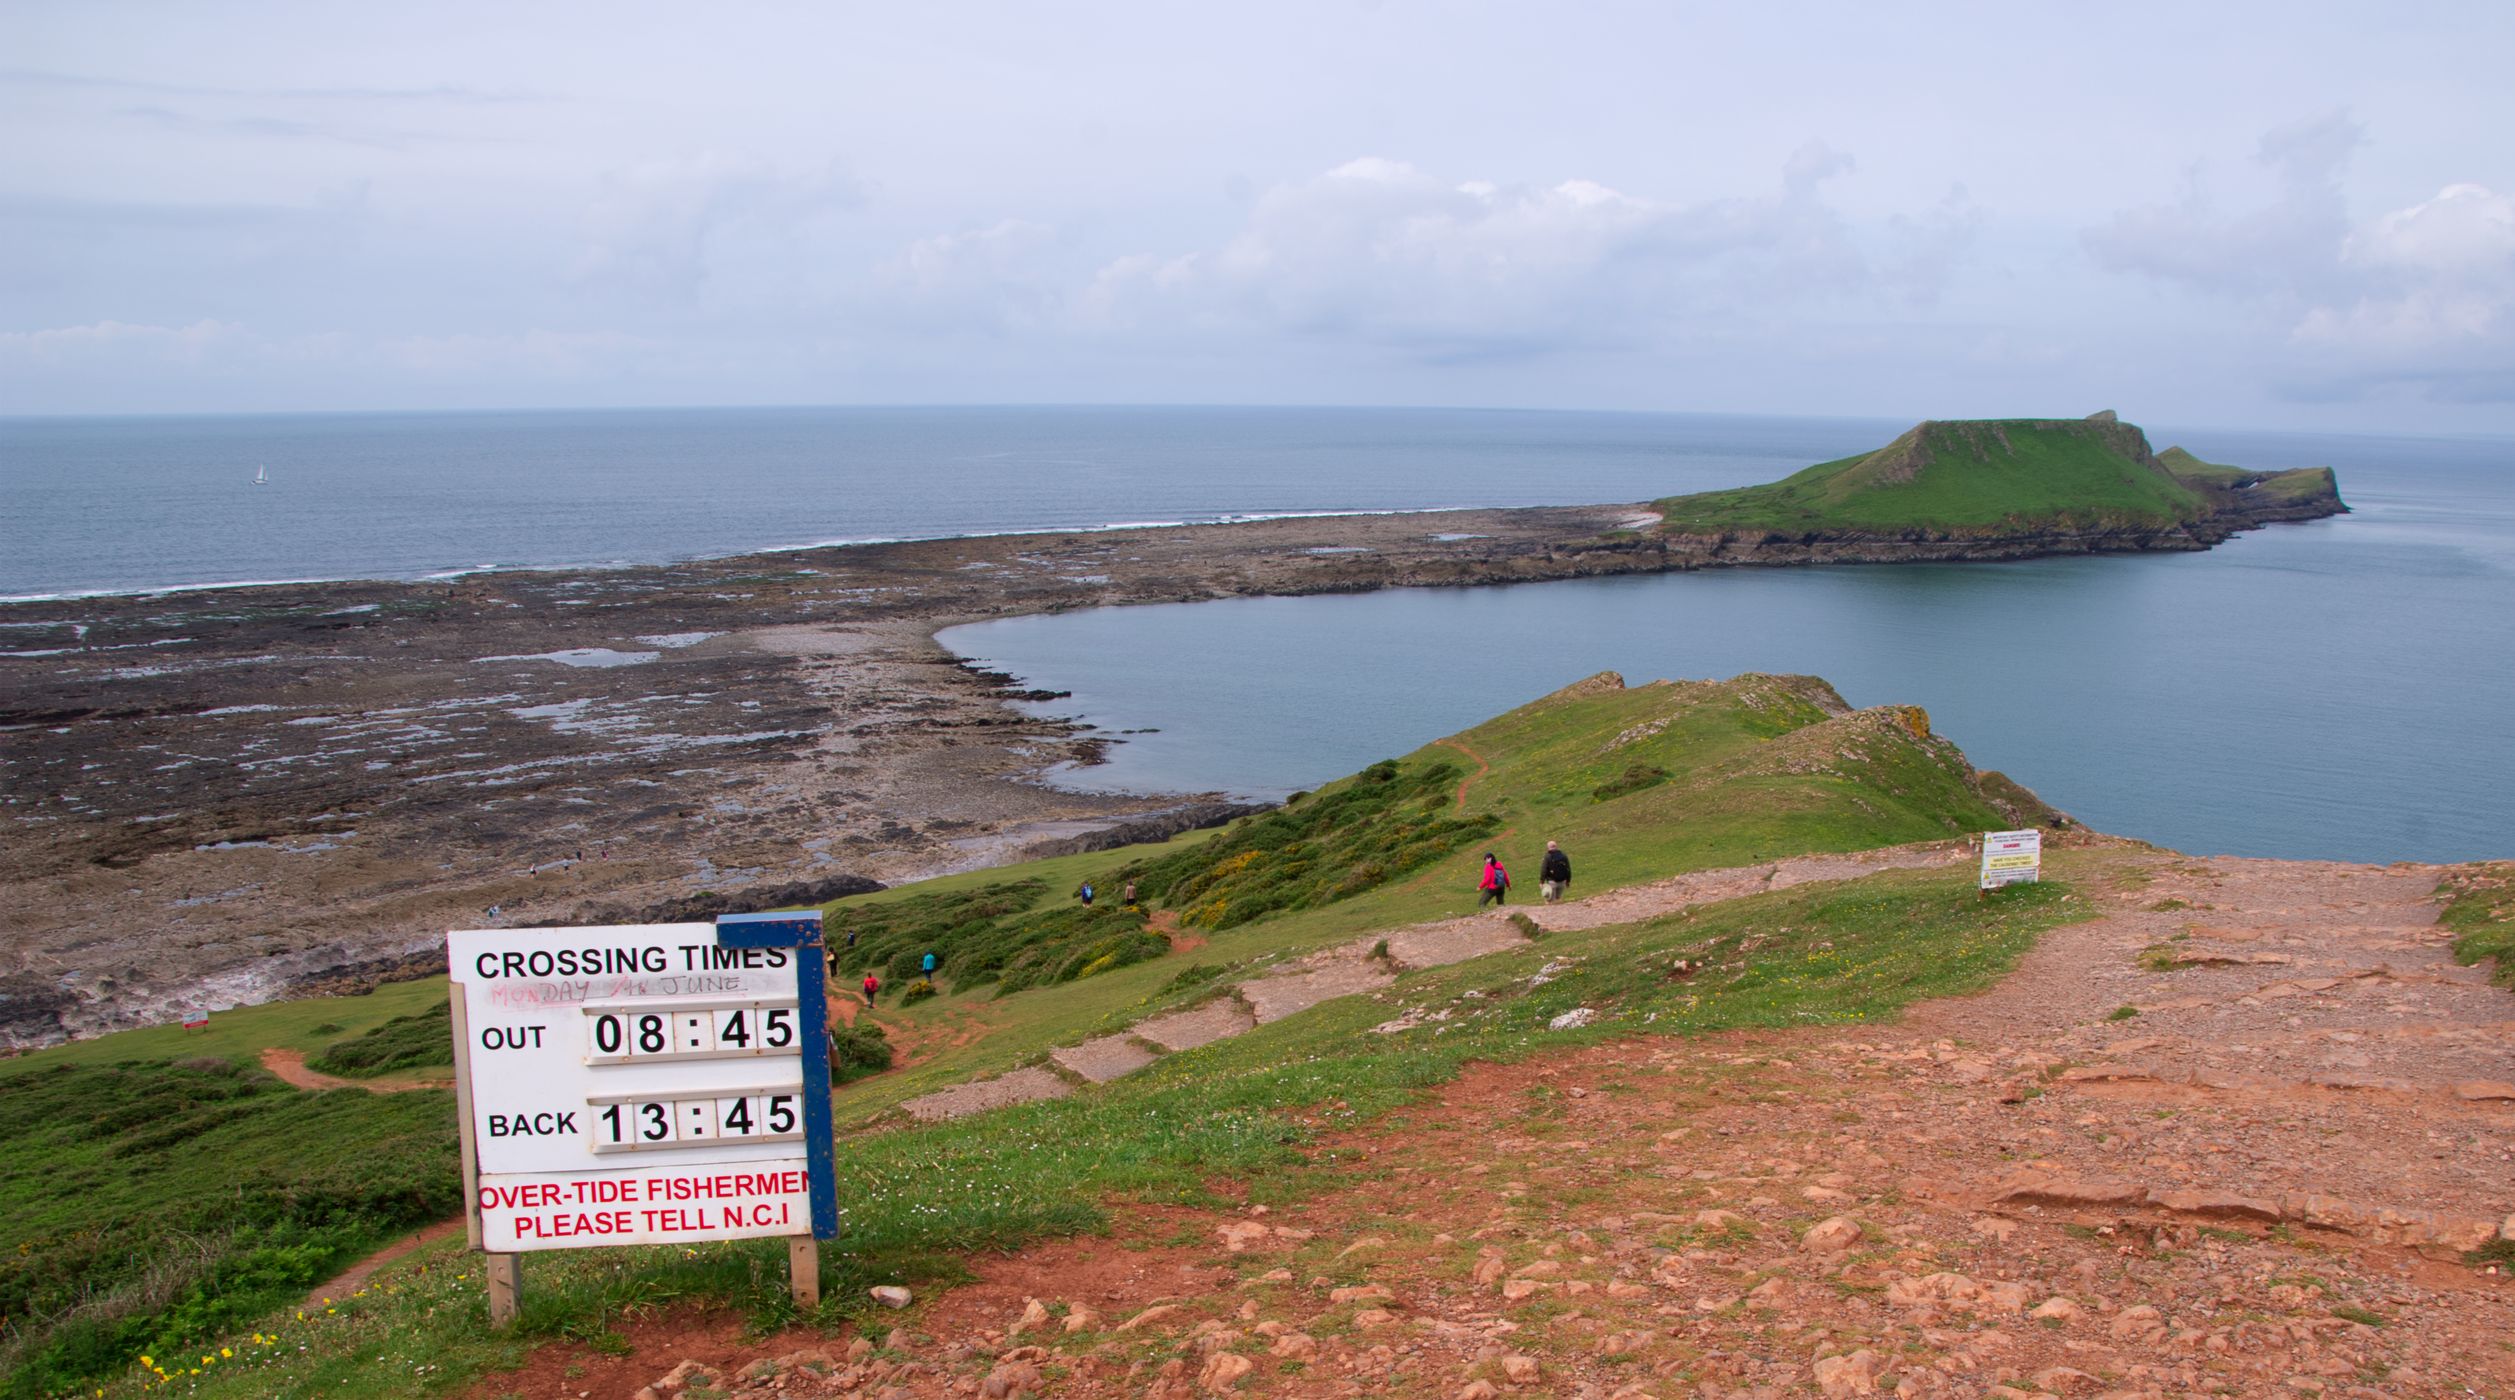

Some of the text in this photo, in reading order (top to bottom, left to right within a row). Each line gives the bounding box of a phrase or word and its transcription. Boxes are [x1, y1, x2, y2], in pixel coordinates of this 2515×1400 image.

[476, 945, 788, 979] CROSSING TIMES
[491, 980, 590, 1006] MONDAY
[660, 975, 741, 995] JUNE
[482, 1025, 547, 1050] OUT
[489, 1111, 578, 1137] BACK
[480, 1179, 638, 1210] OVER-TIDE
[514, 1202, 789, 1239] PLEASE TELL N.C.I
